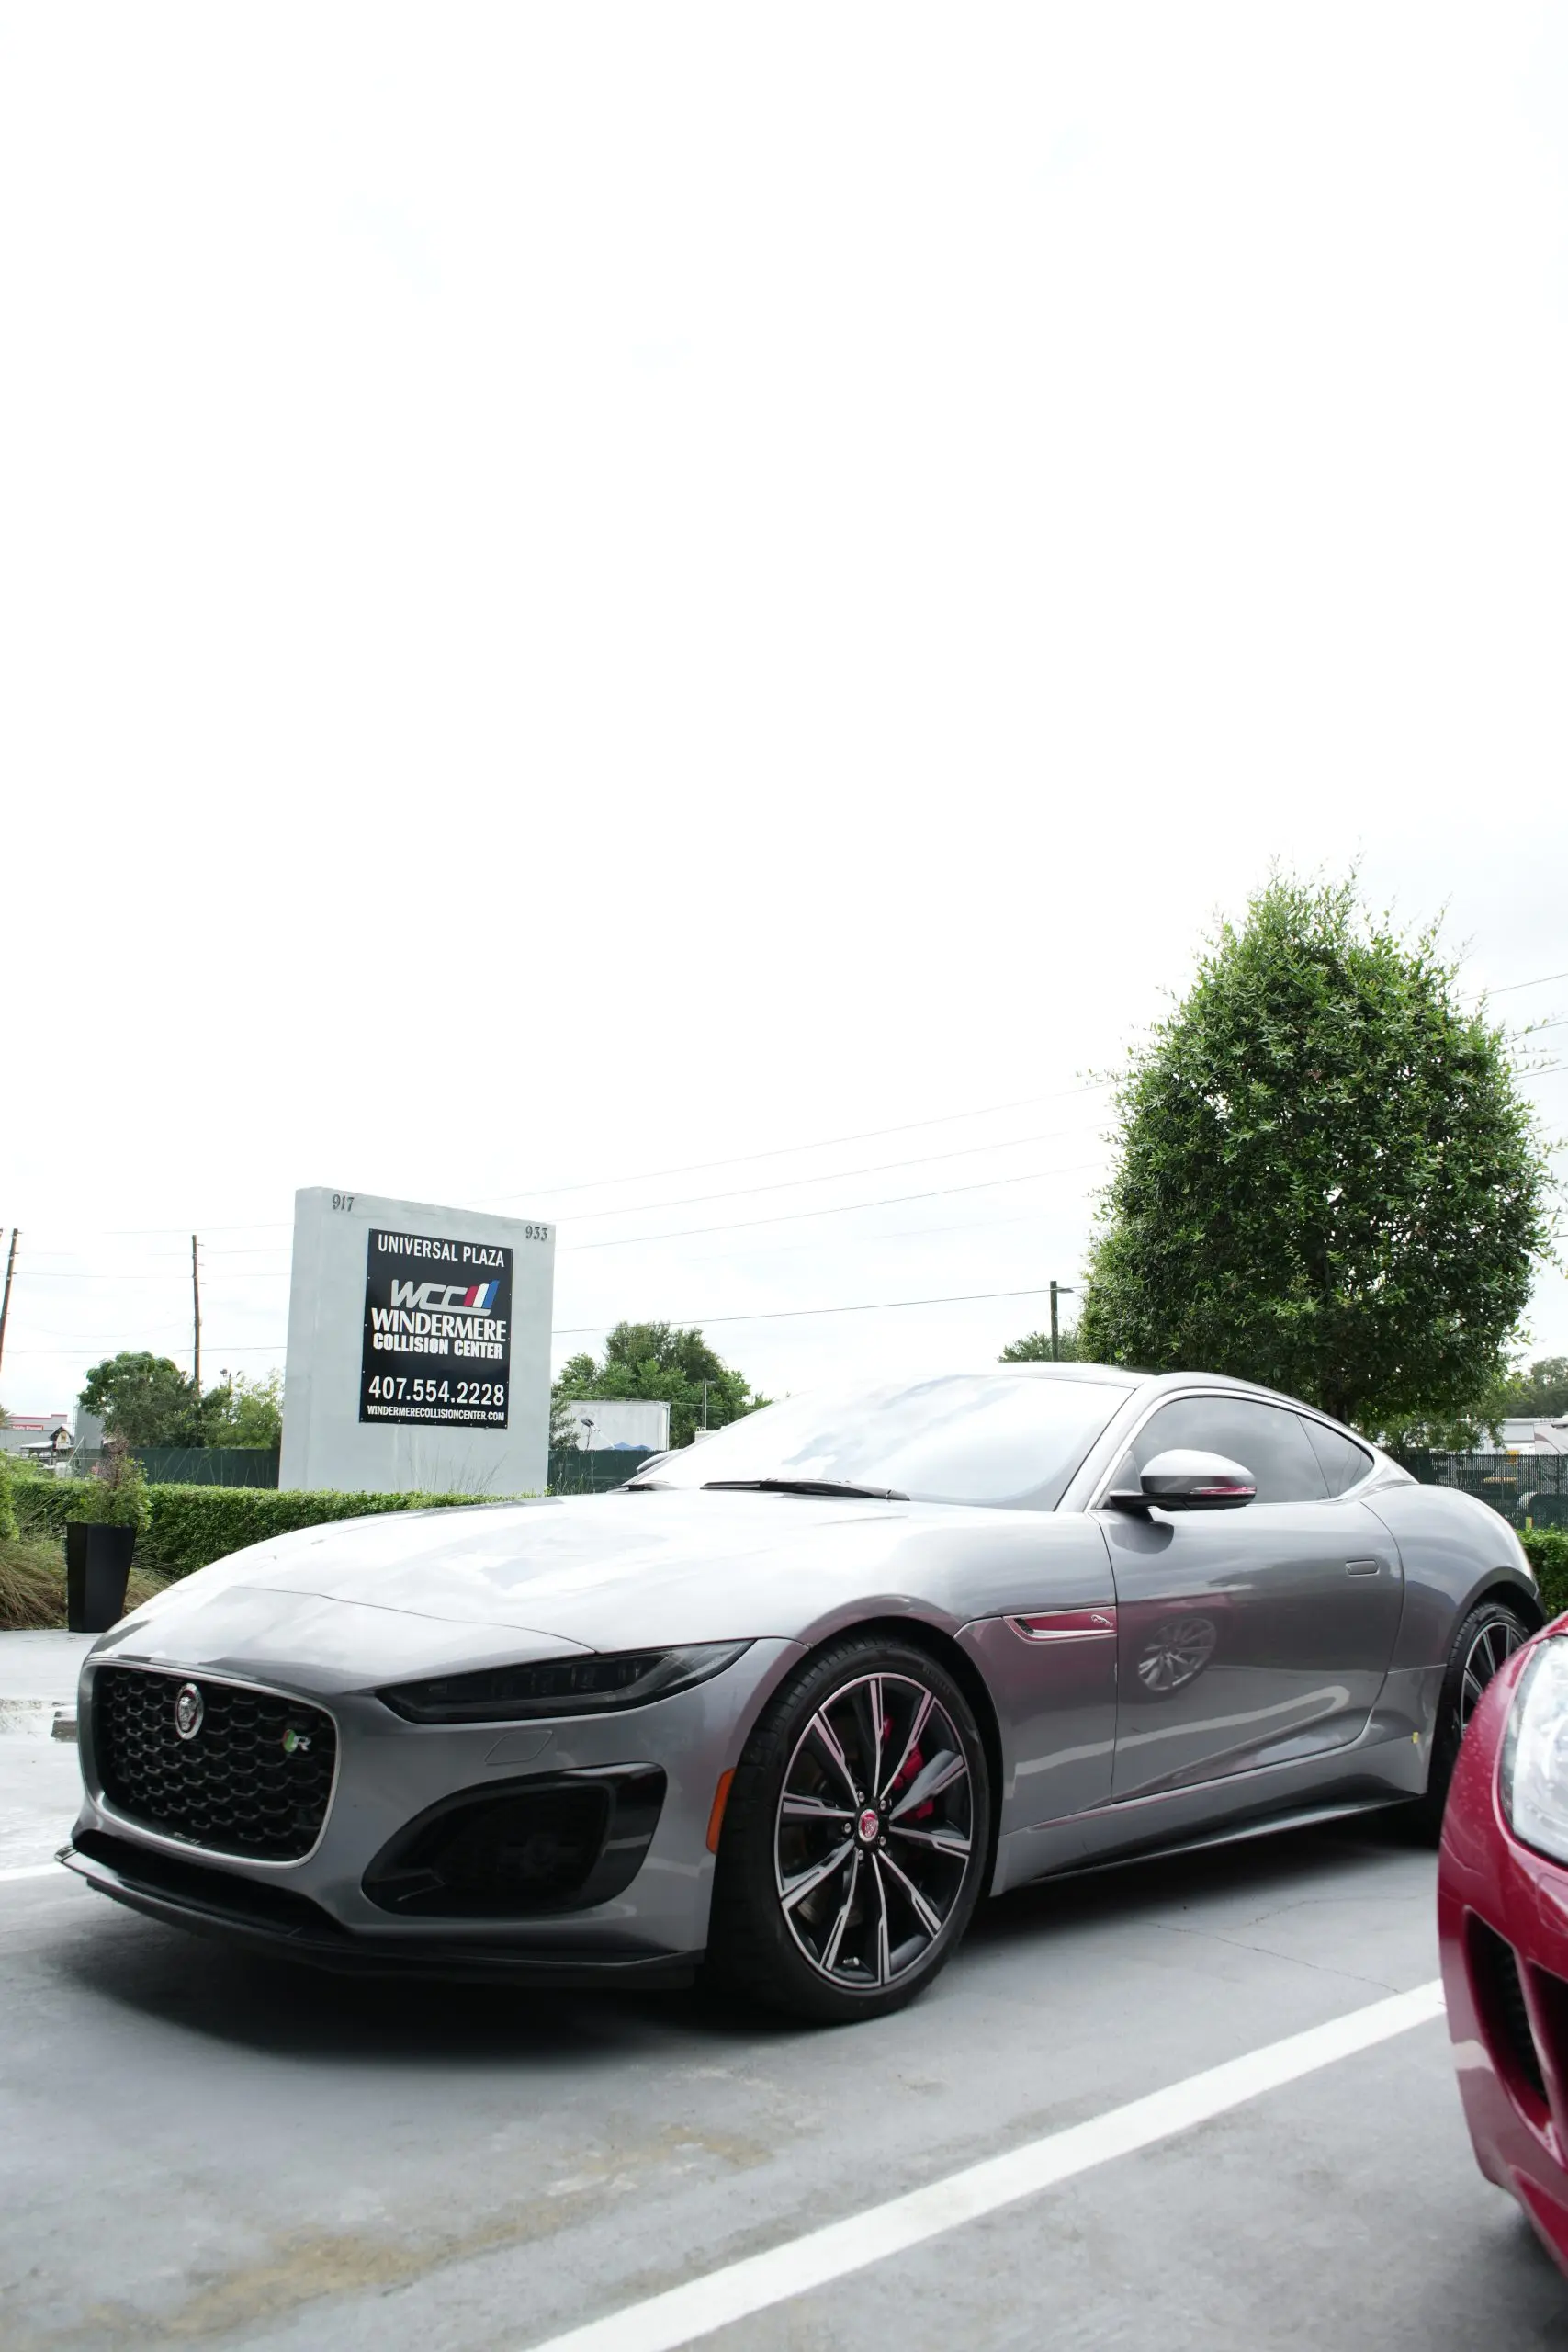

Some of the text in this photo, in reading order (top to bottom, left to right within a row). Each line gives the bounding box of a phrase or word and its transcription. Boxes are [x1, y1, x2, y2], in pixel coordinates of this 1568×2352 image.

[332, 1194, 355, 1212] 917
[525, 1226, 548, 1241] 933
[378, 1234, 505, 1268] UNIVERSAL PLAZA
[371, 1307, 506, 1342] WINDERMERE
[373, 1333, 503, 1360] COLLISION CENTER
[368, 1375, 505, 1406] 407.554.2228
[367, 1405, 505, 1421] WINDERMERECOLLISIONCENTER.COM
